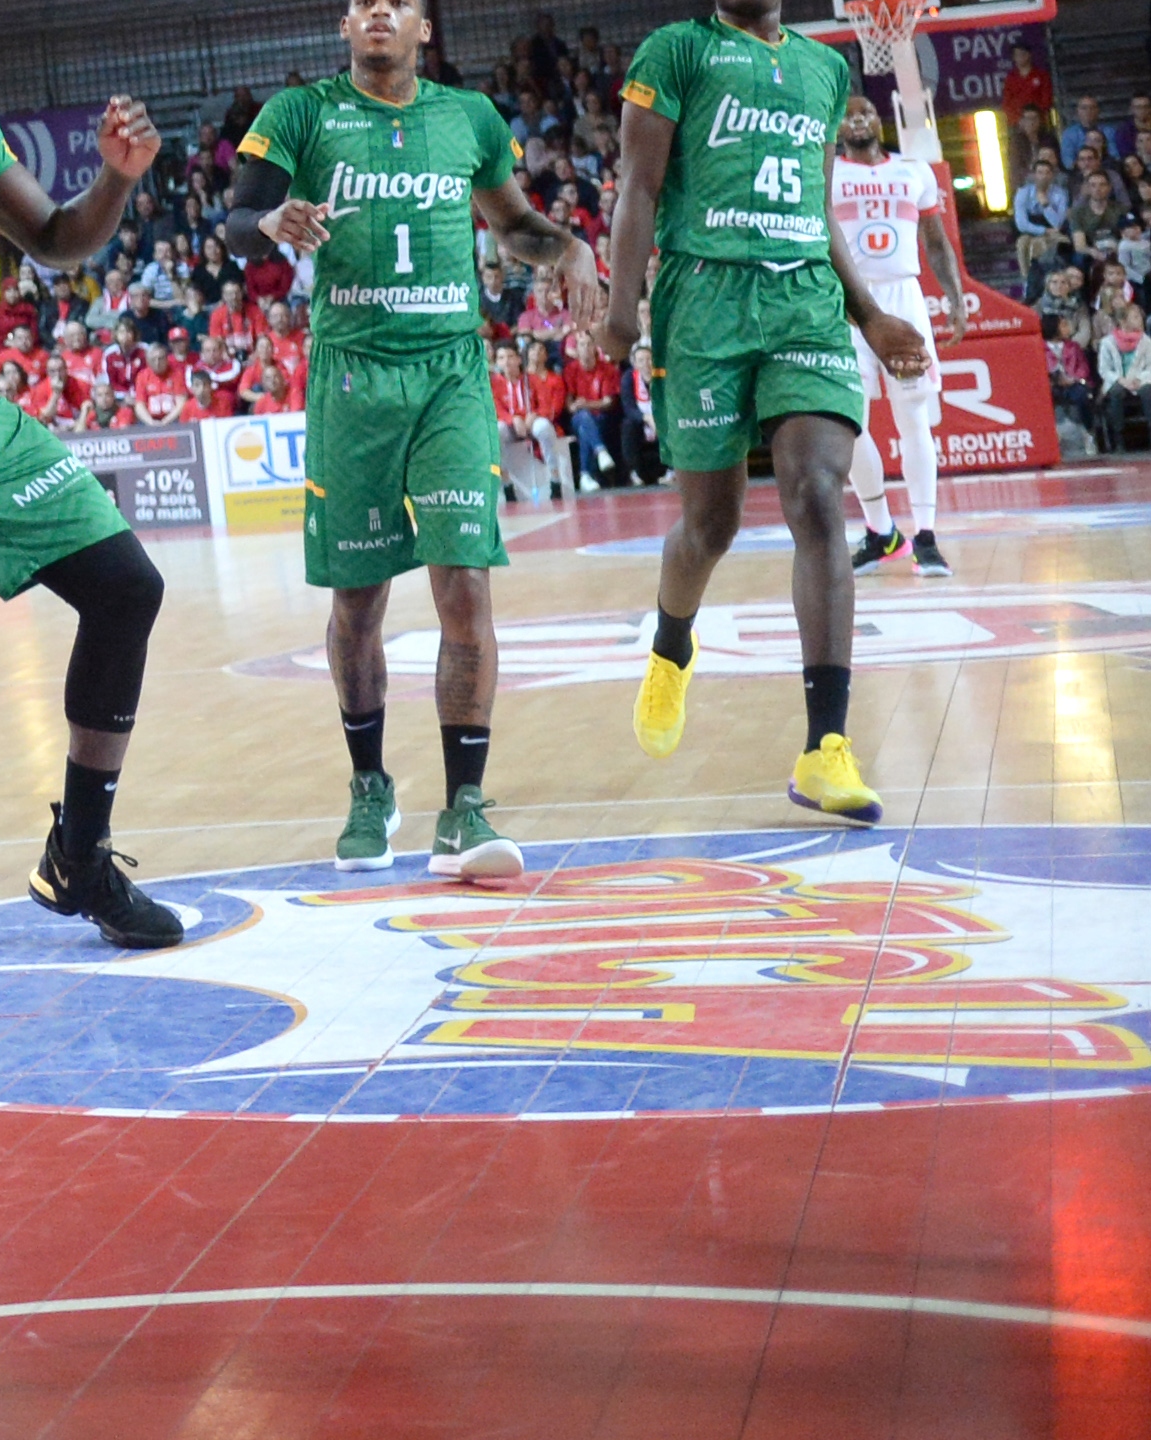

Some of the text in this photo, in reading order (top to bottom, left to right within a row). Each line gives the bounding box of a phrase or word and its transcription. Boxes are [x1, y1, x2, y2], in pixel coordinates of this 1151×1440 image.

[707, 93, 828, 149] Limoges
[68, 129, 99, 154] PA
[327, 161, 469, 220] Limoges
[754, 155, 802, 203] 45
[841, 182, 910, 198] CHOLET
[864, 198, 891, 219] 21
[393, 223, 414, 275] 1
[677, 412, 742, 430] EMAKINA
[947, 429, 1035, 453] ROUYER
[935, 448, 1028, 468] OMOBILES
[135, 468, 196, 494] -10%
[134, 492, 197, 506] les soirs
[135, 506, 203, 522] de match
